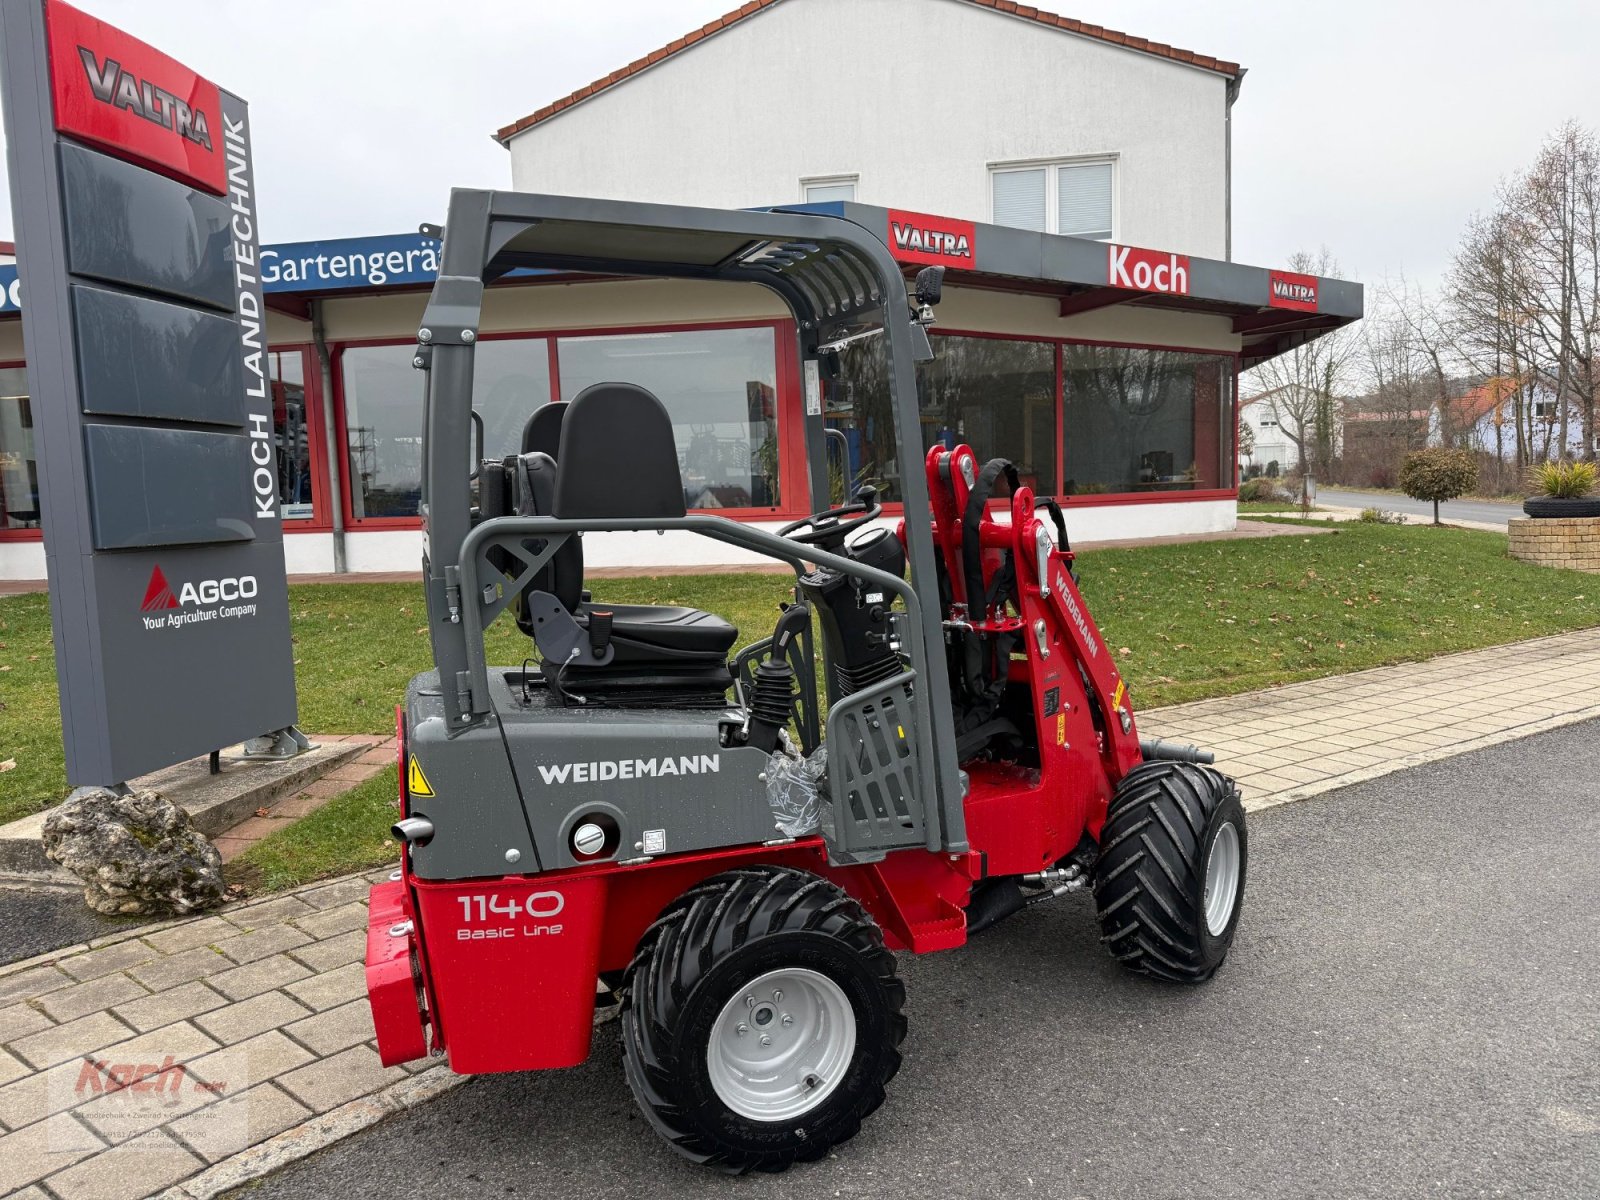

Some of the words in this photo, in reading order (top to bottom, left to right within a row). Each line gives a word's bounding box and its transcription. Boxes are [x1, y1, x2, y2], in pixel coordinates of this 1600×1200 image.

[77, 44, 213, 153] VALTRA
[223, 112, 268, 399] LANDTECHNIK
[891, 221, 971, 258] VALTRA
[259, 240, 442, 285] Gartengerä
[1109, 245, 1188, 294] Koch
[1272, 277, 1316, 304] VALTRA
[249, 413, 275, 519] KOCH
[179, 575, 258, 607] AGCO
[142, 617, 166, 630] Your
[167, 609, 218, 629] Agriculture
[220, 603, 257, 618] Company
[1056, 571, 1098, 659] WEIDEMANN
[537, 753, 720, 785] WEIDEMANN
[457, 890, 565, 922] 1140
[457, 926, 516, 941] Basic
[523, 924, 564, 937] Line
